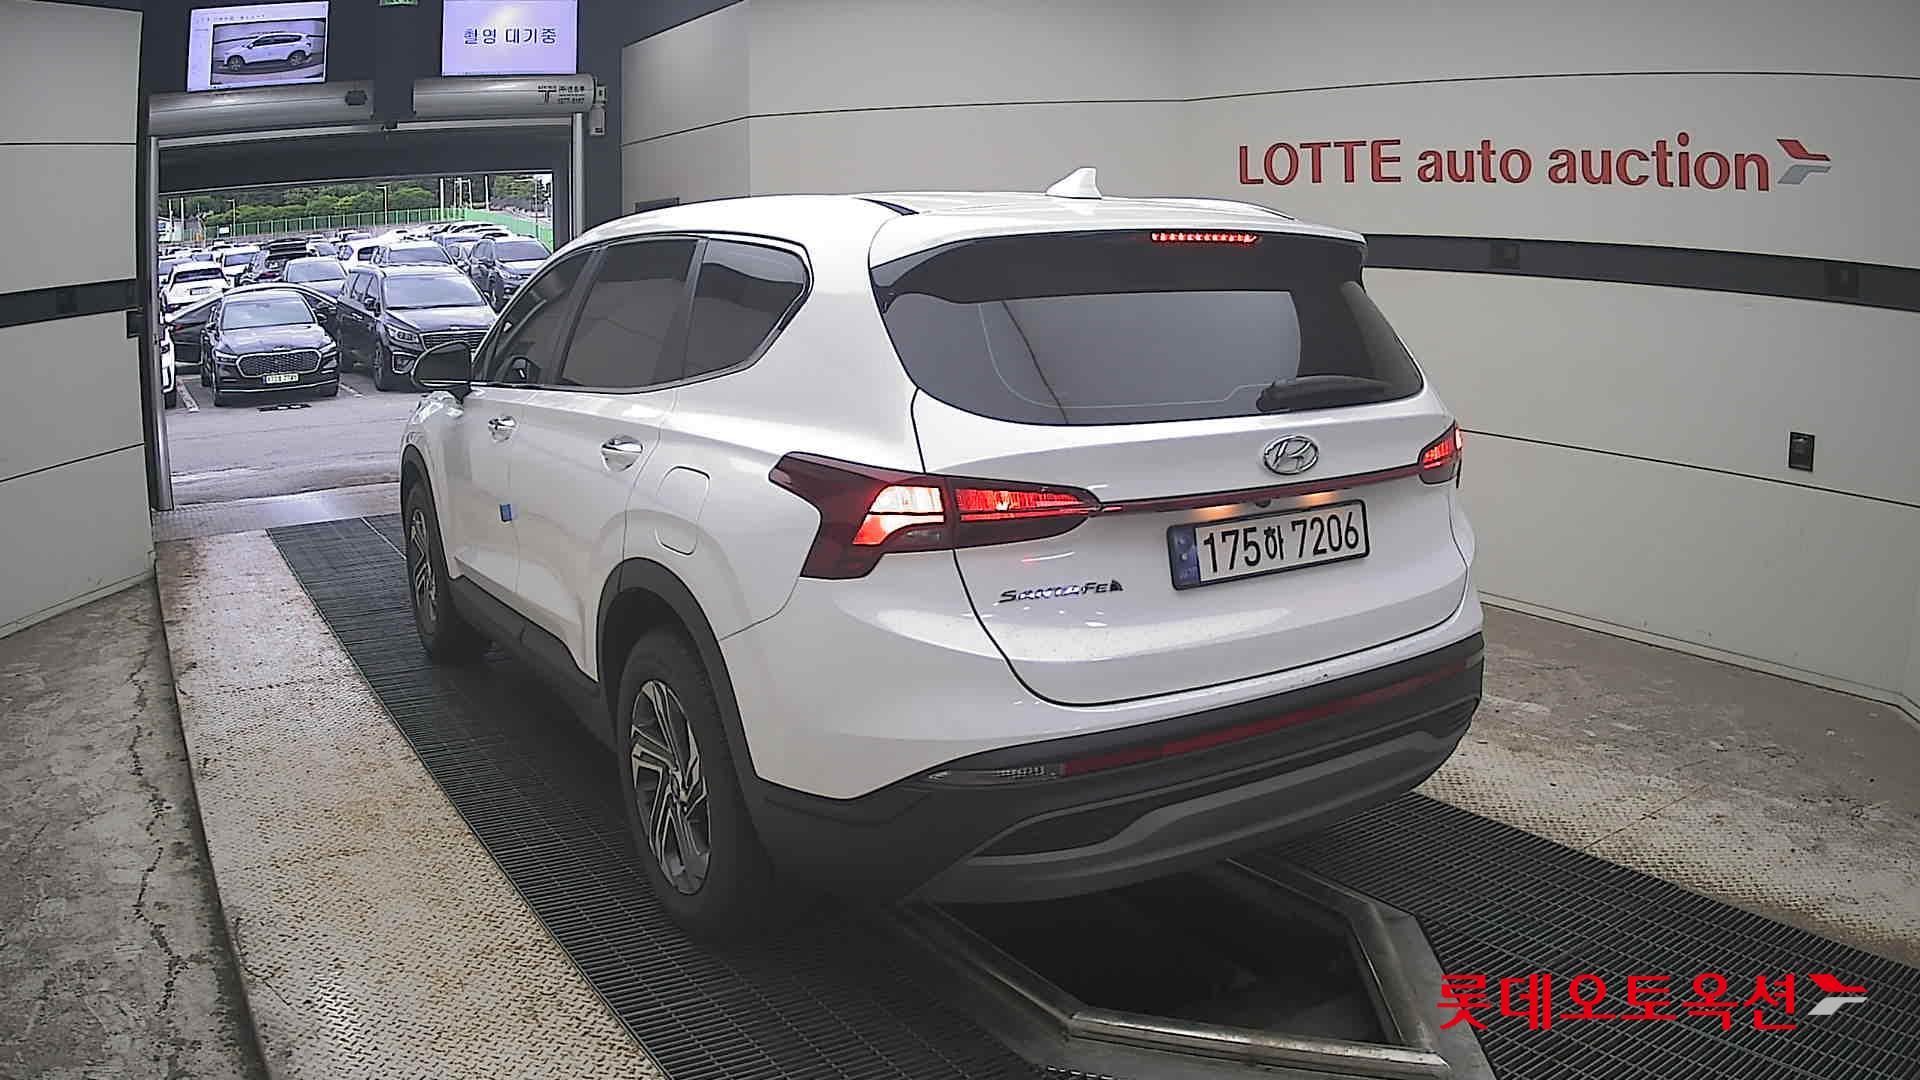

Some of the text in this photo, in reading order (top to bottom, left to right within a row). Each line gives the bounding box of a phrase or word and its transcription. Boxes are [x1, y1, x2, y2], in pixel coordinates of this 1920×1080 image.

[505, 28, 557, 44] 대기중
[1239, 132, 1770, 191] LOTTE auto auction
[1203, 511, 1359, 573] 175하 7206
